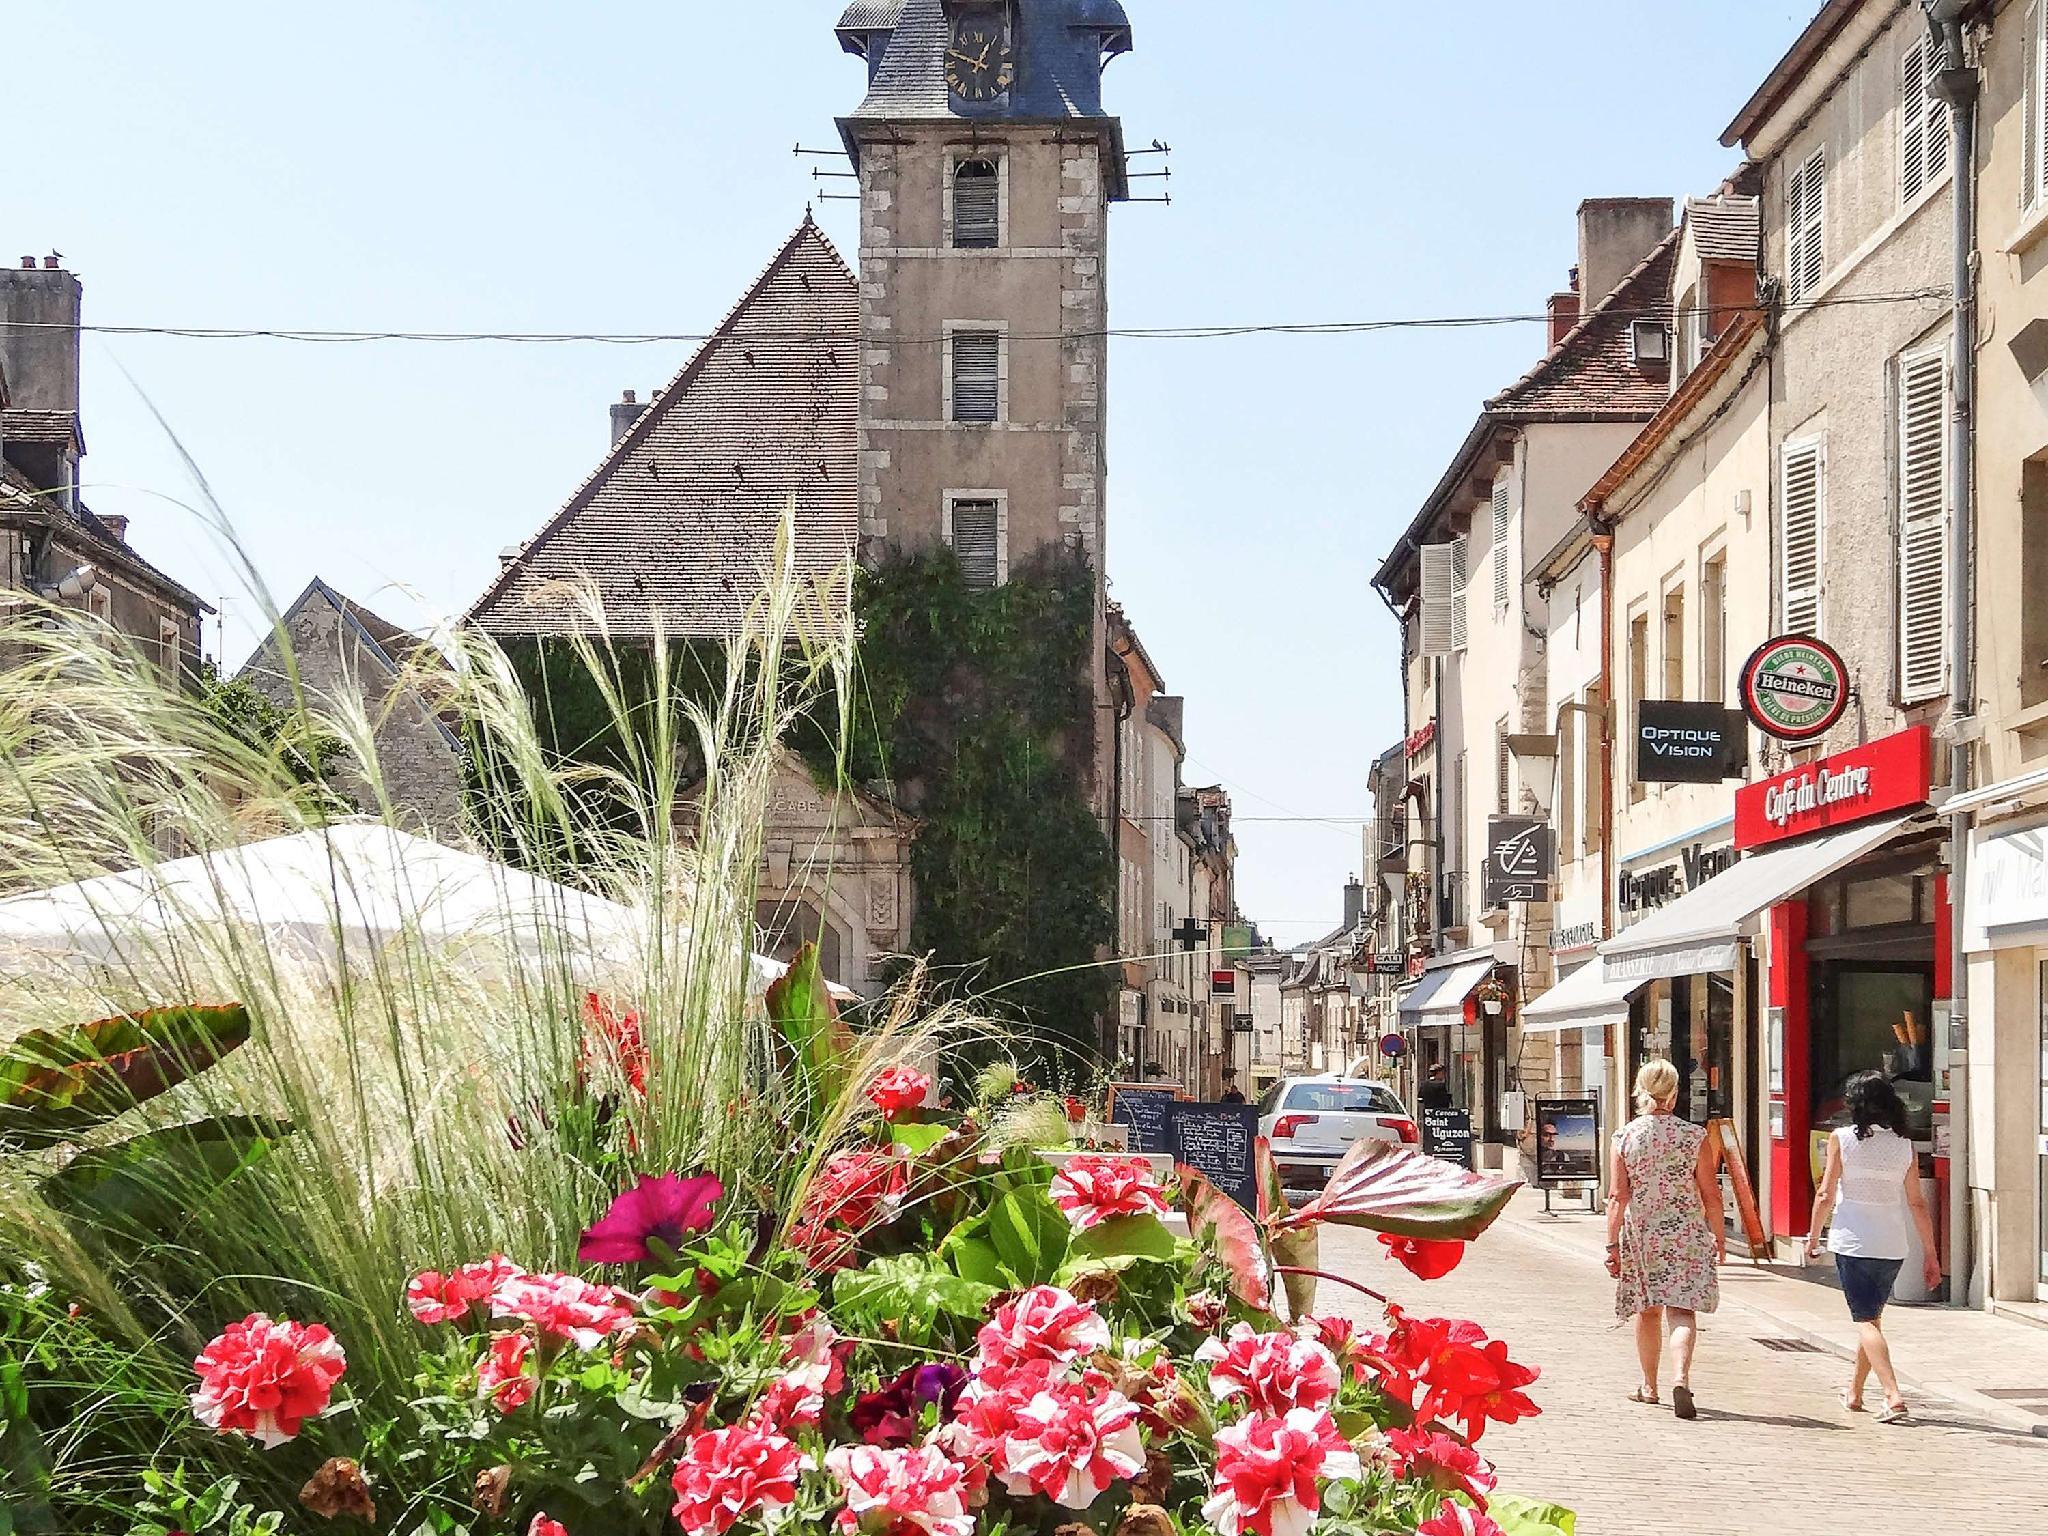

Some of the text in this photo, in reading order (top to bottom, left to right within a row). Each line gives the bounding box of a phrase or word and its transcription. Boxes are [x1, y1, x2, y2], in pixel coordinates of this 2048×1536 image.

[1761, 674, 1833, 699] Heineken
[1765, 765, 1869, 826] Café du Centre
[1425, 1117, 1448, 1126] Saint
[1432, 1127, 1470, 1140] Uguzon
